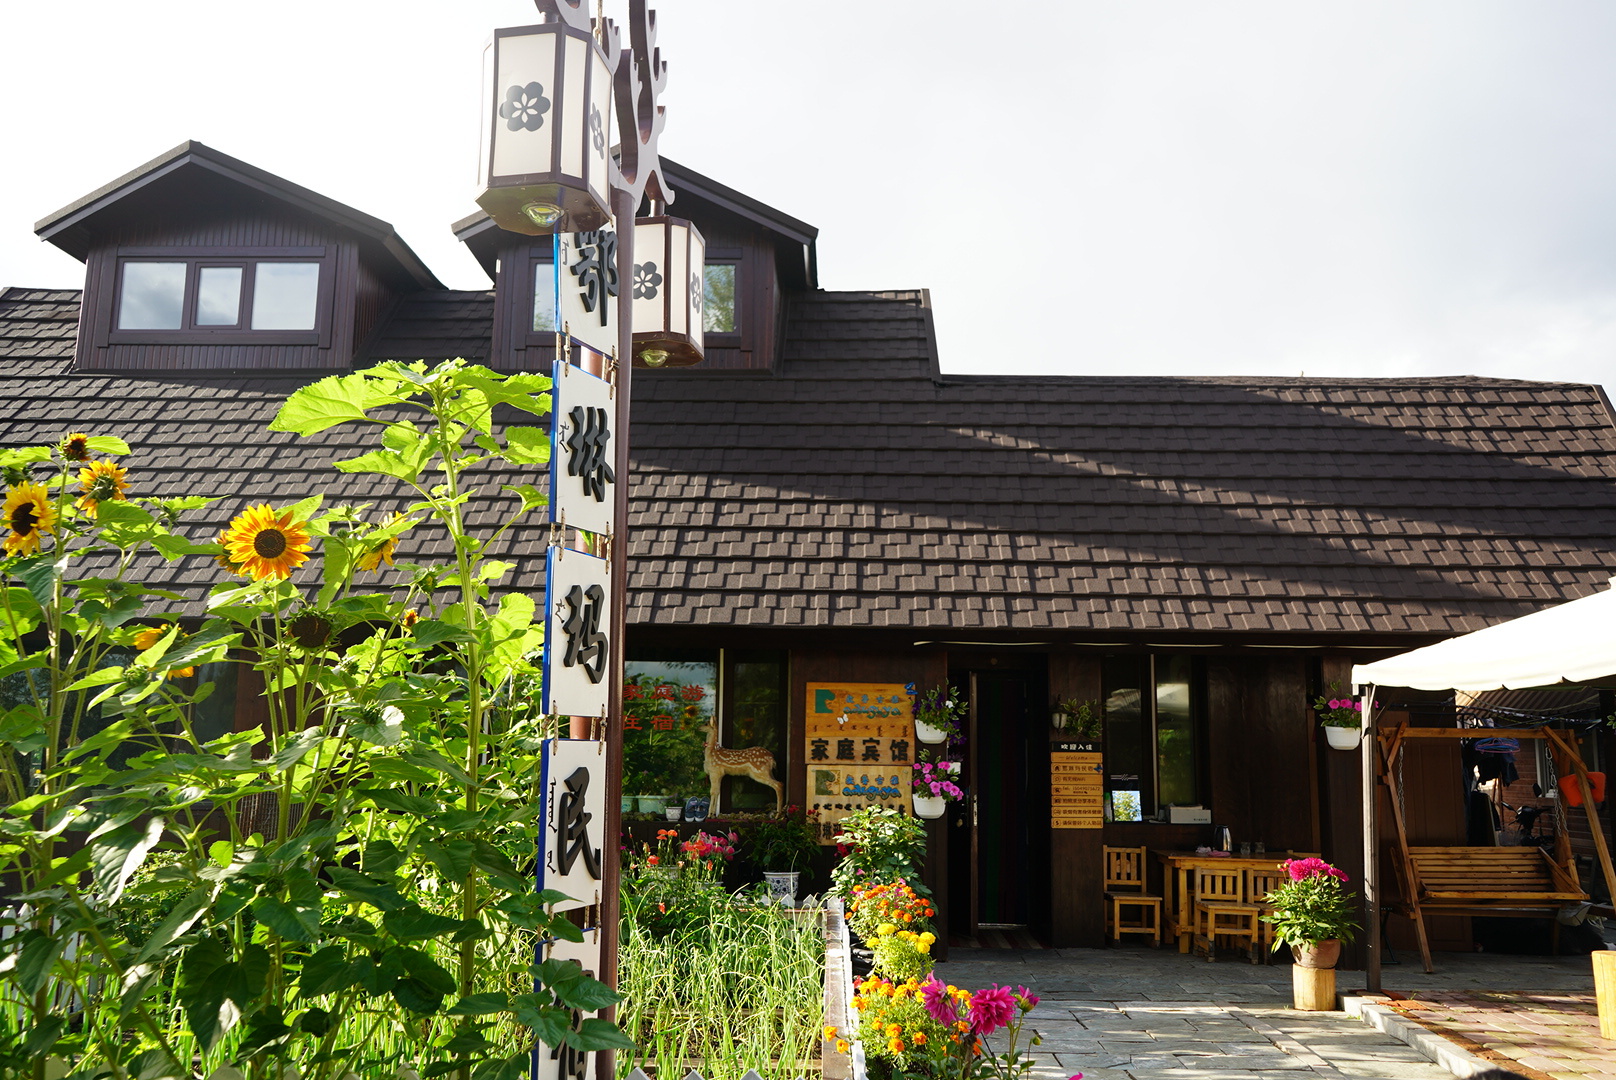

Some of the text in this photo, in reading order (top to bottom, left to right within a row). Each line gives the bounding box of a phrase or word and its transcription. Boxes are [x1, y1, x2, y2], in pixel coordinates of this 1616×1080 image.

[623, 684, 707, 701] 家庭游
[810, 738, 910, 762] 家庭宾馆
[845, 774, 900, 785] 敖鲁古雅
